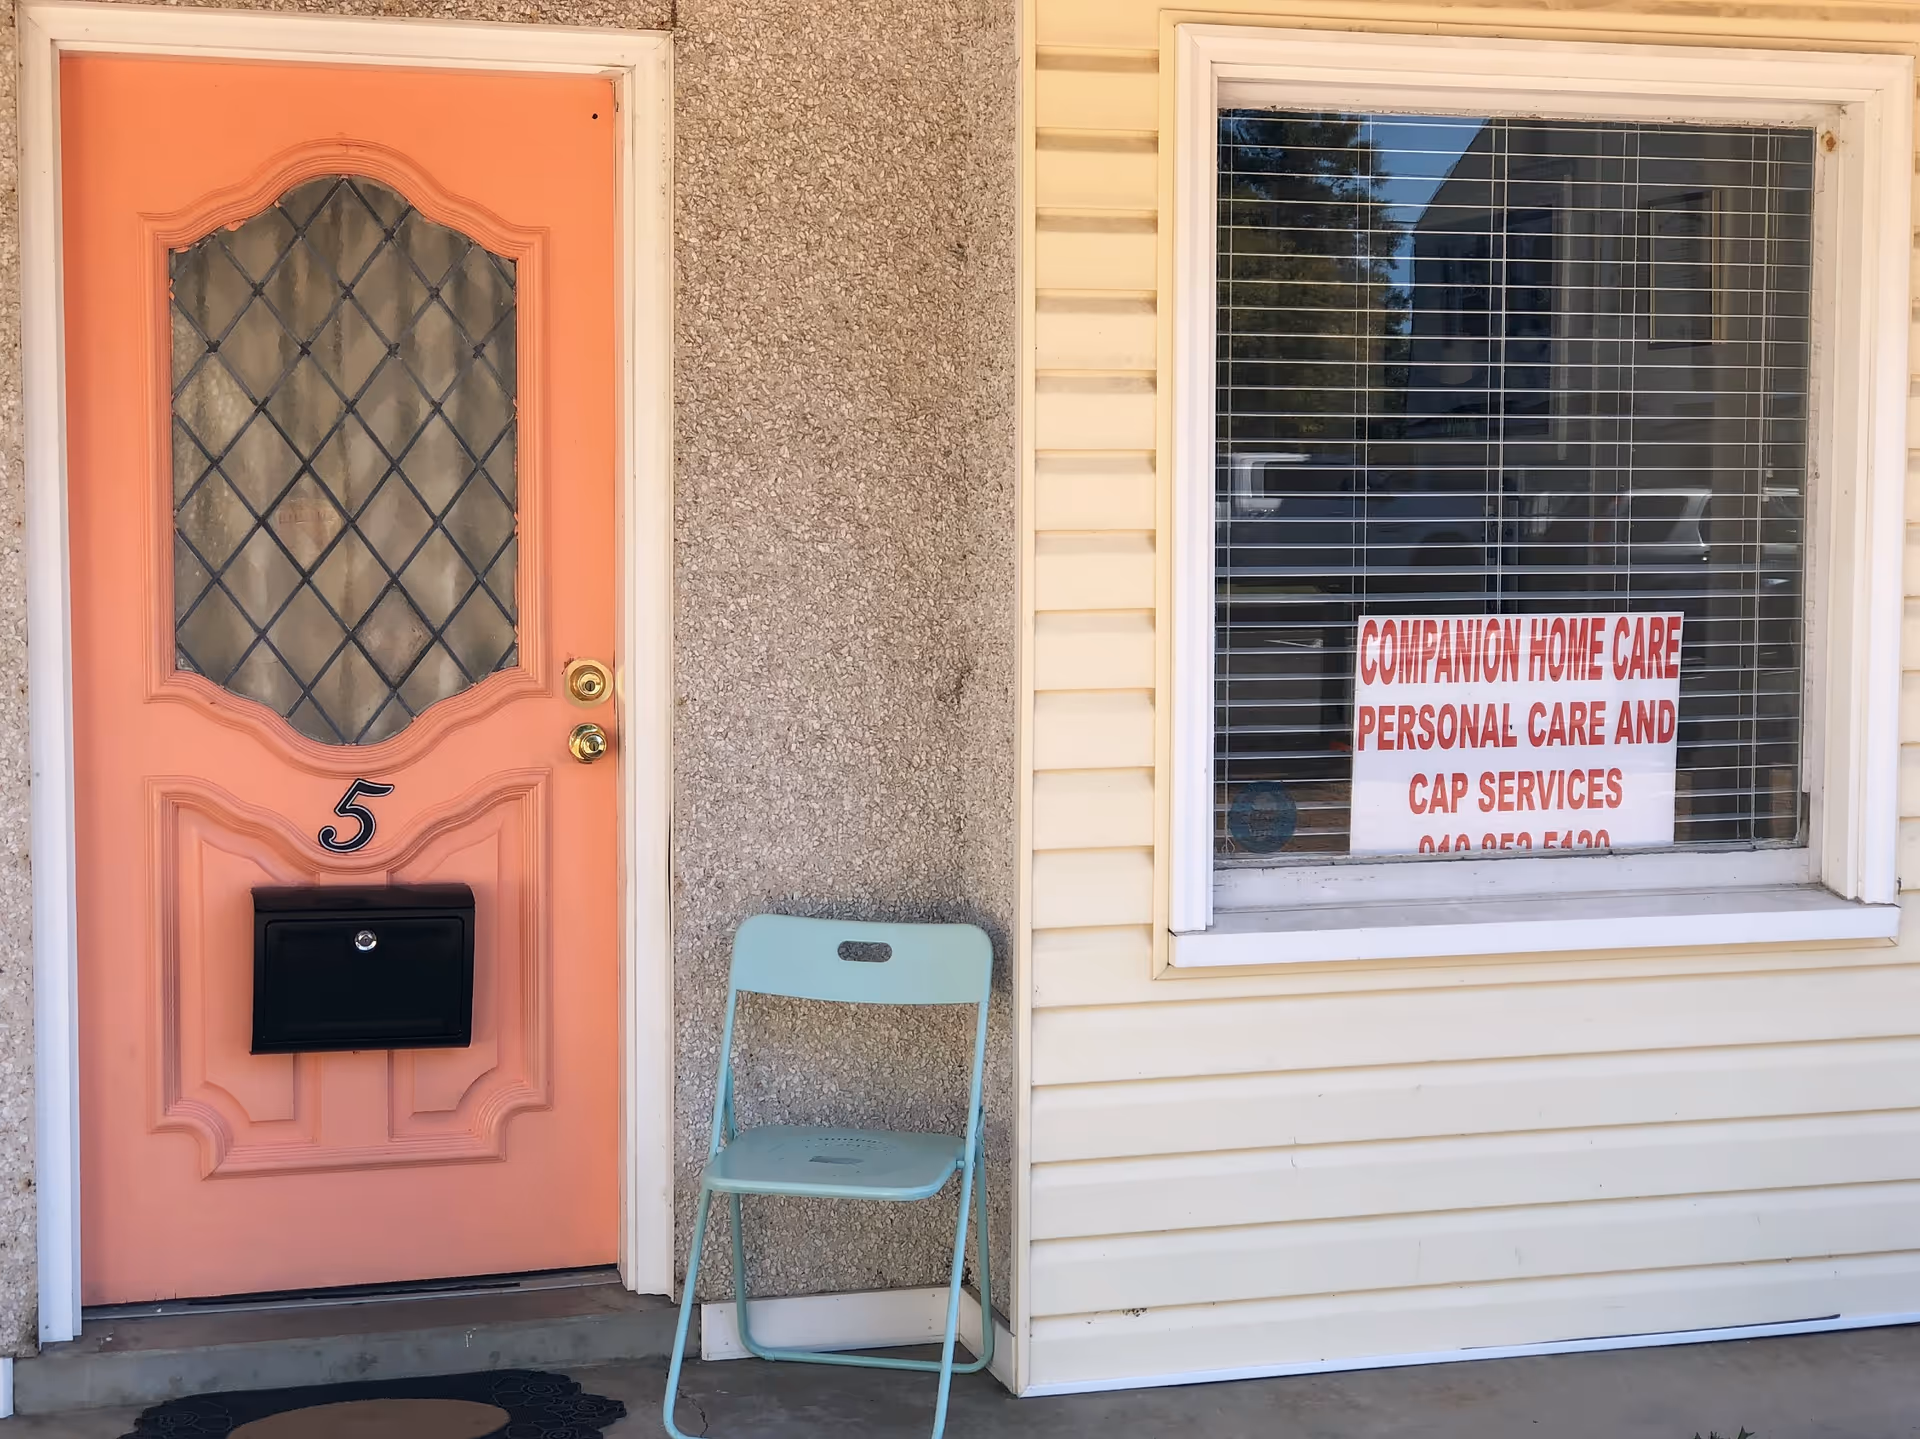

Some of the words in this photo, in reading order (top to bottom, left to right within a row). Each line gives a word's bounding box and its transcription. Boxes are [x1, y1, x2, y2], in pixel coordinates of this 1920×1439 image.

[1360, 617, 1522, 686] COMPANION
[1528, 616, 1606, 682] HOME
[1612, 615, 1682, 681] CARE
[1357, 702, 1518, 752] PERSONAL
[1527, 700, 1606, 748] CARE
[1614, 699, 1676, 745] AND
[318, 778, 395, 853] 5
[1408, 772, 1469, 815] CAP
[1477, 766, 1623, 813] SERVICES
